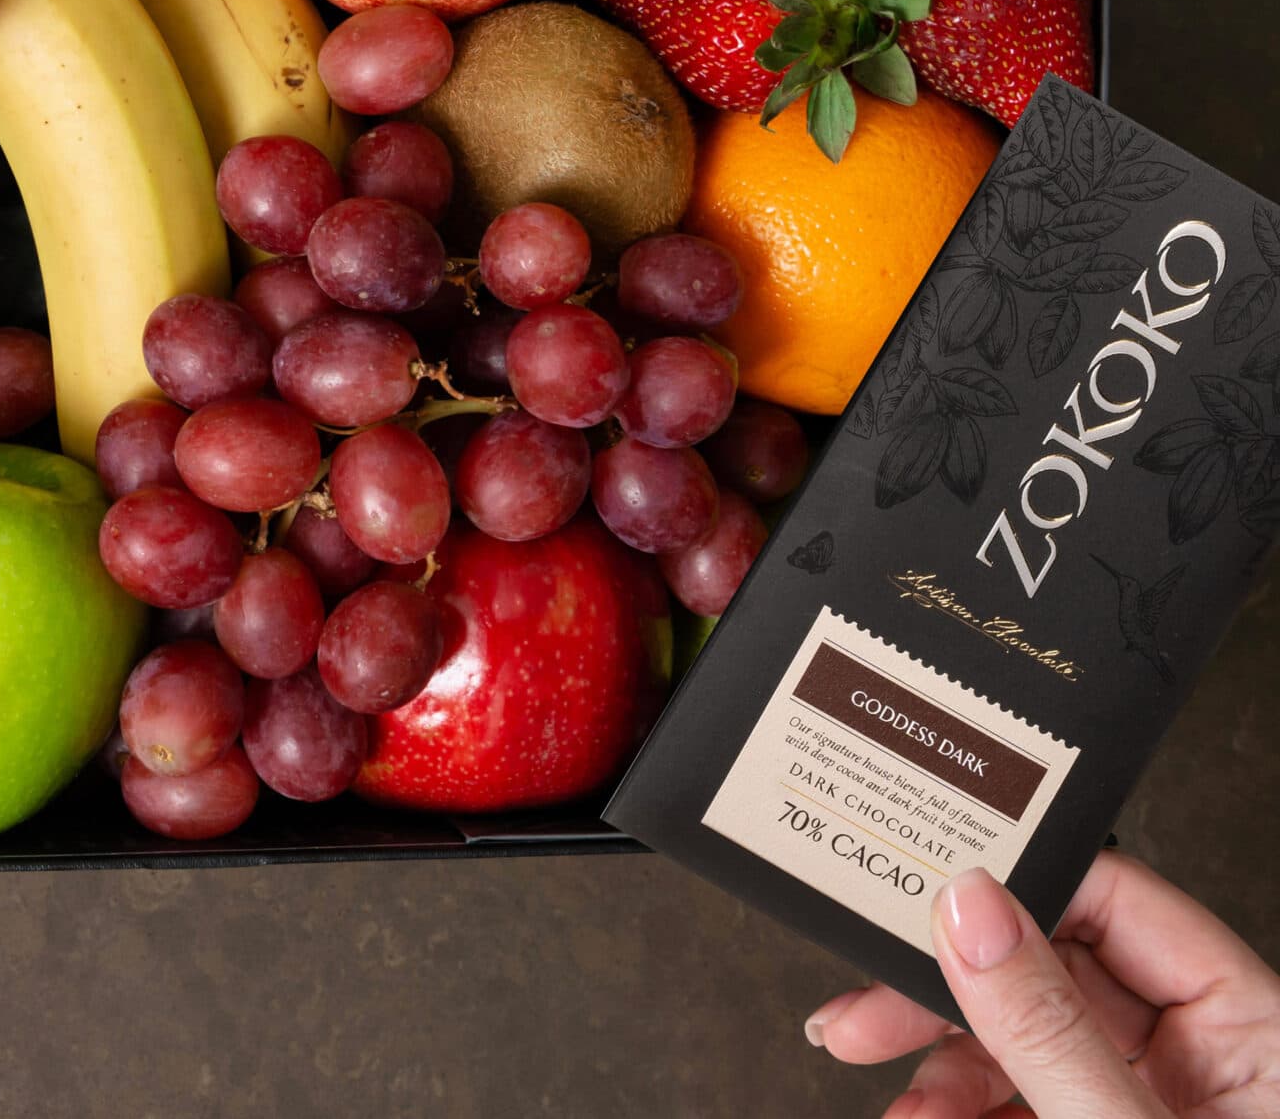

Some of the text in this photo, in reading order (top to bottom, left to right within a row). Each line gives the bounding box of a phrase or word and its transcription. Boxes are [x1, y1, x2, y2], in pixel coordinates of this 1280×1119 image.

[974, 219, 1227, 599] ZOKOKO
[982, 616, 1085, 682] Chocolate
[788, 716, 1000, 840] Our signature house blend, full of flavour
[850, 690, 990, 778] GODDESS DARK
[784, 733, 987, 852] with deep cocoa and dark fruit top notes
[788, 761, 957, 864] DARK CHOCOLATE
[777, 800, 925, 896] 70% CACAO
